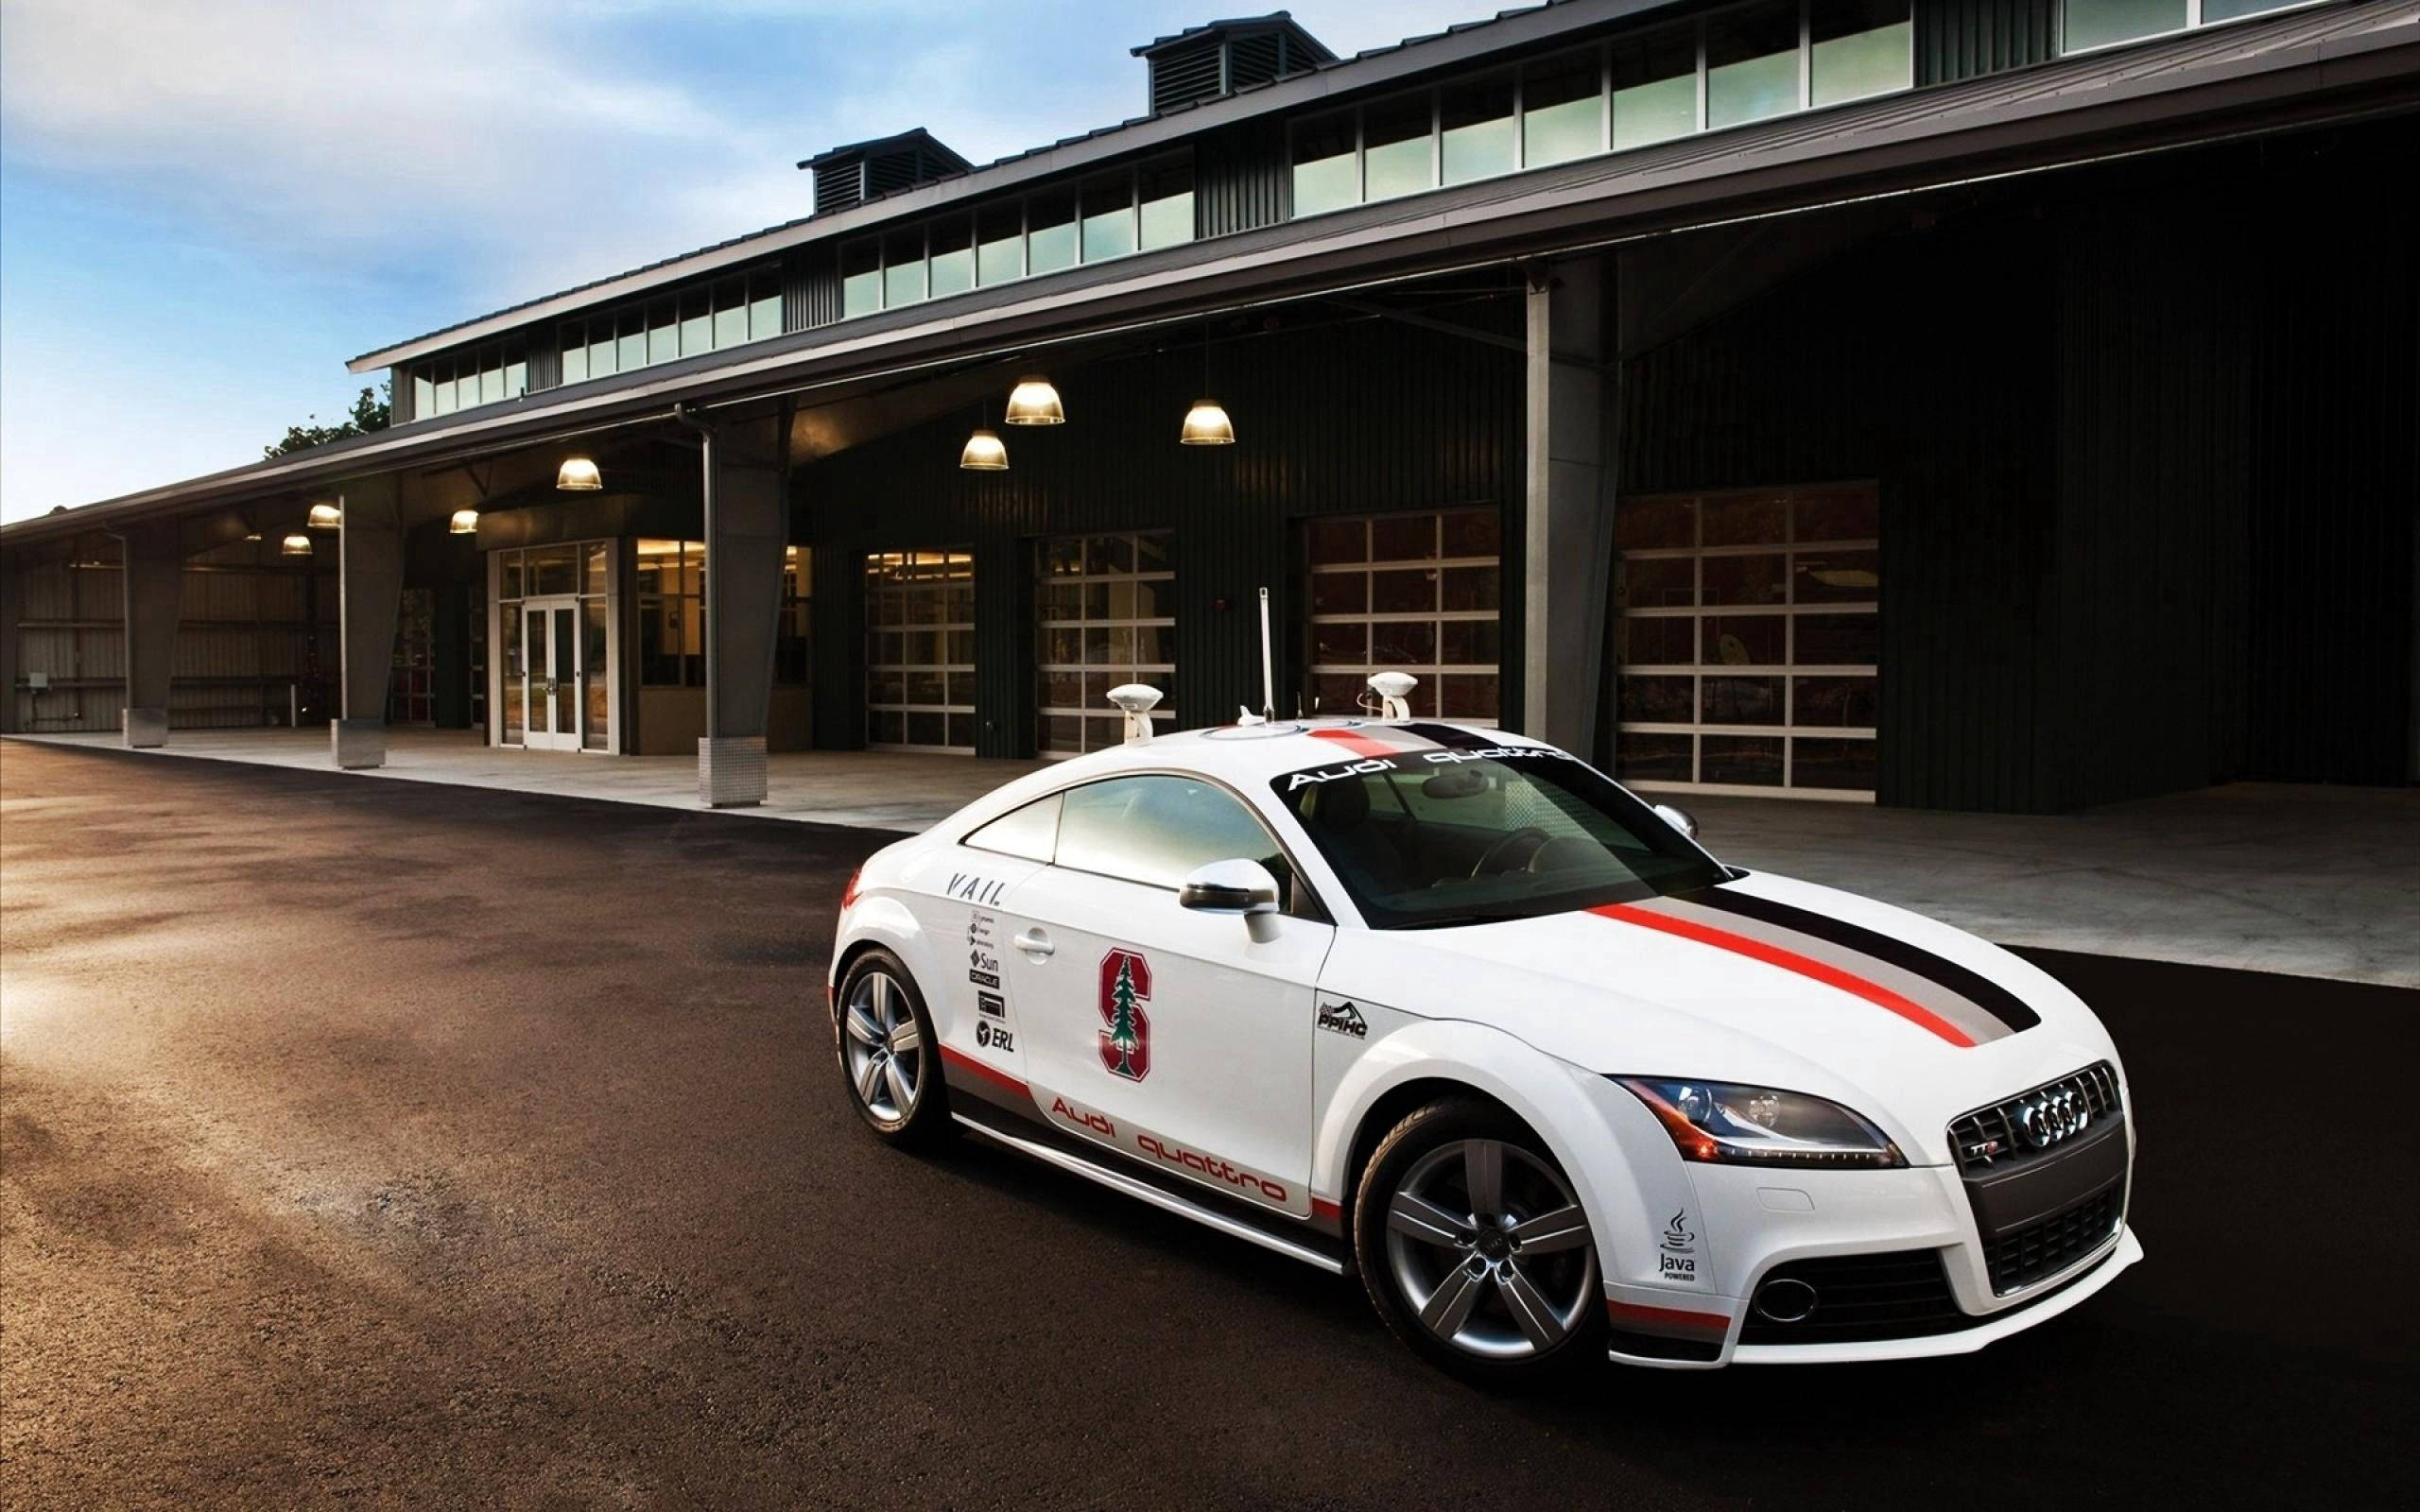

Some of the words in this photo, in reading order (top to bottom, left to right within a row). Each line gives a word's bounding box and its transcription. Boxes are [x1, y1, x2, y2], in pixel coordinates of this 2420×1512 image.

[947, 873, 1005, 906] VAIL
[980, 953, 999, 972] Sun
[992, 1027, 1014, 1053] ERL
[1051, 1096, 1116, 1138] Audi
[1137, 1134, 1288, 1203] quattro
[1659, 1253, 1695, 1272] Java
[1664, 1272, 1695, 1281] POWERED
